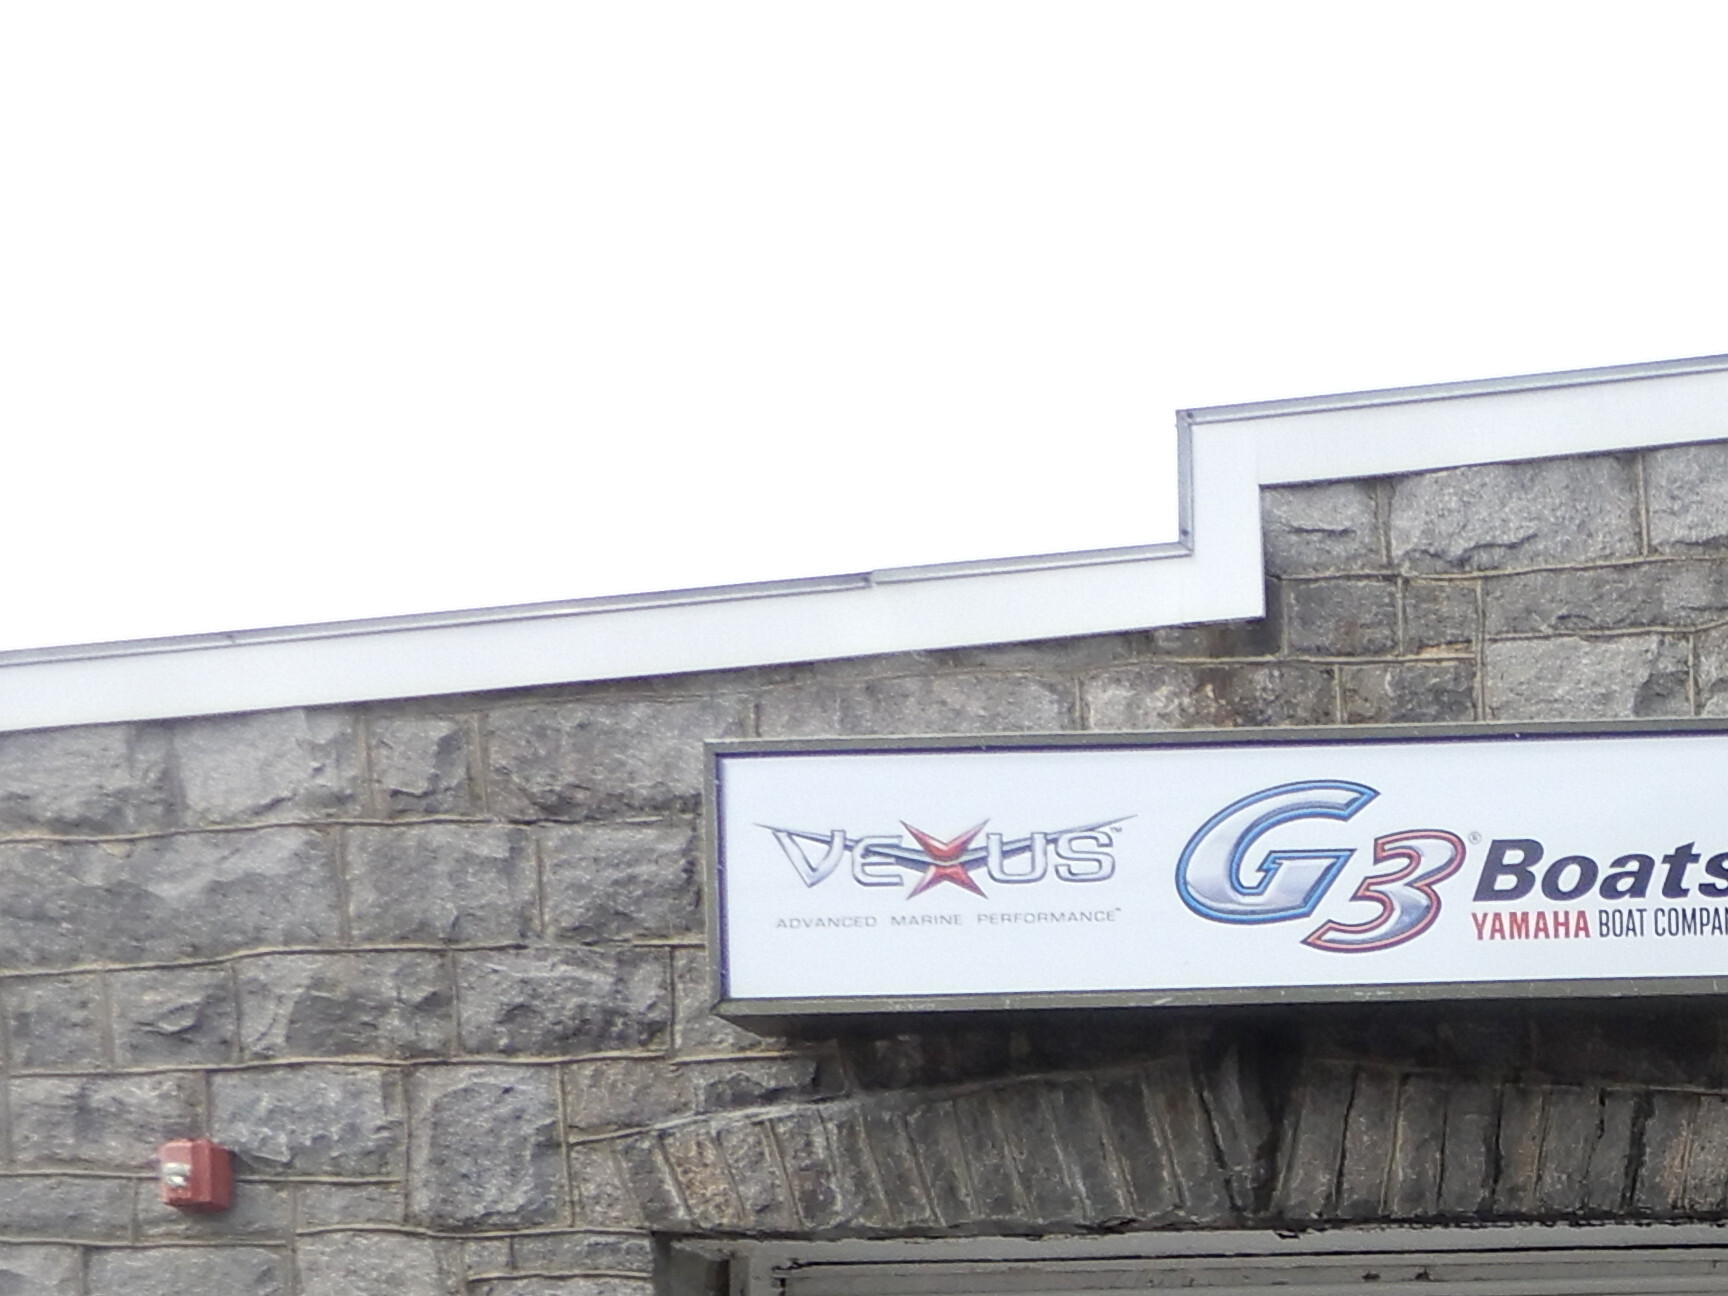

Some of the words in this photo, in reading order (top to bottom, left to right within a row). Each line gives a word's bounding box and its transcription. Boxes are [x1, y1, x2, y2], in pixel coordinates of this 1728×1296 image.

[769, 818, 1118, 900] VEXUS
[1174, 779, 1467, 954] G3
[775, 915, 877, 930] ADVANCED
[890, 913, 963, 927] MARINE
[977, 909, 1116, 925] PERFORMANCE
[1471, 909, 1591, 941] YAMAHA
[1598, 908, 1648, 939] BOAT
